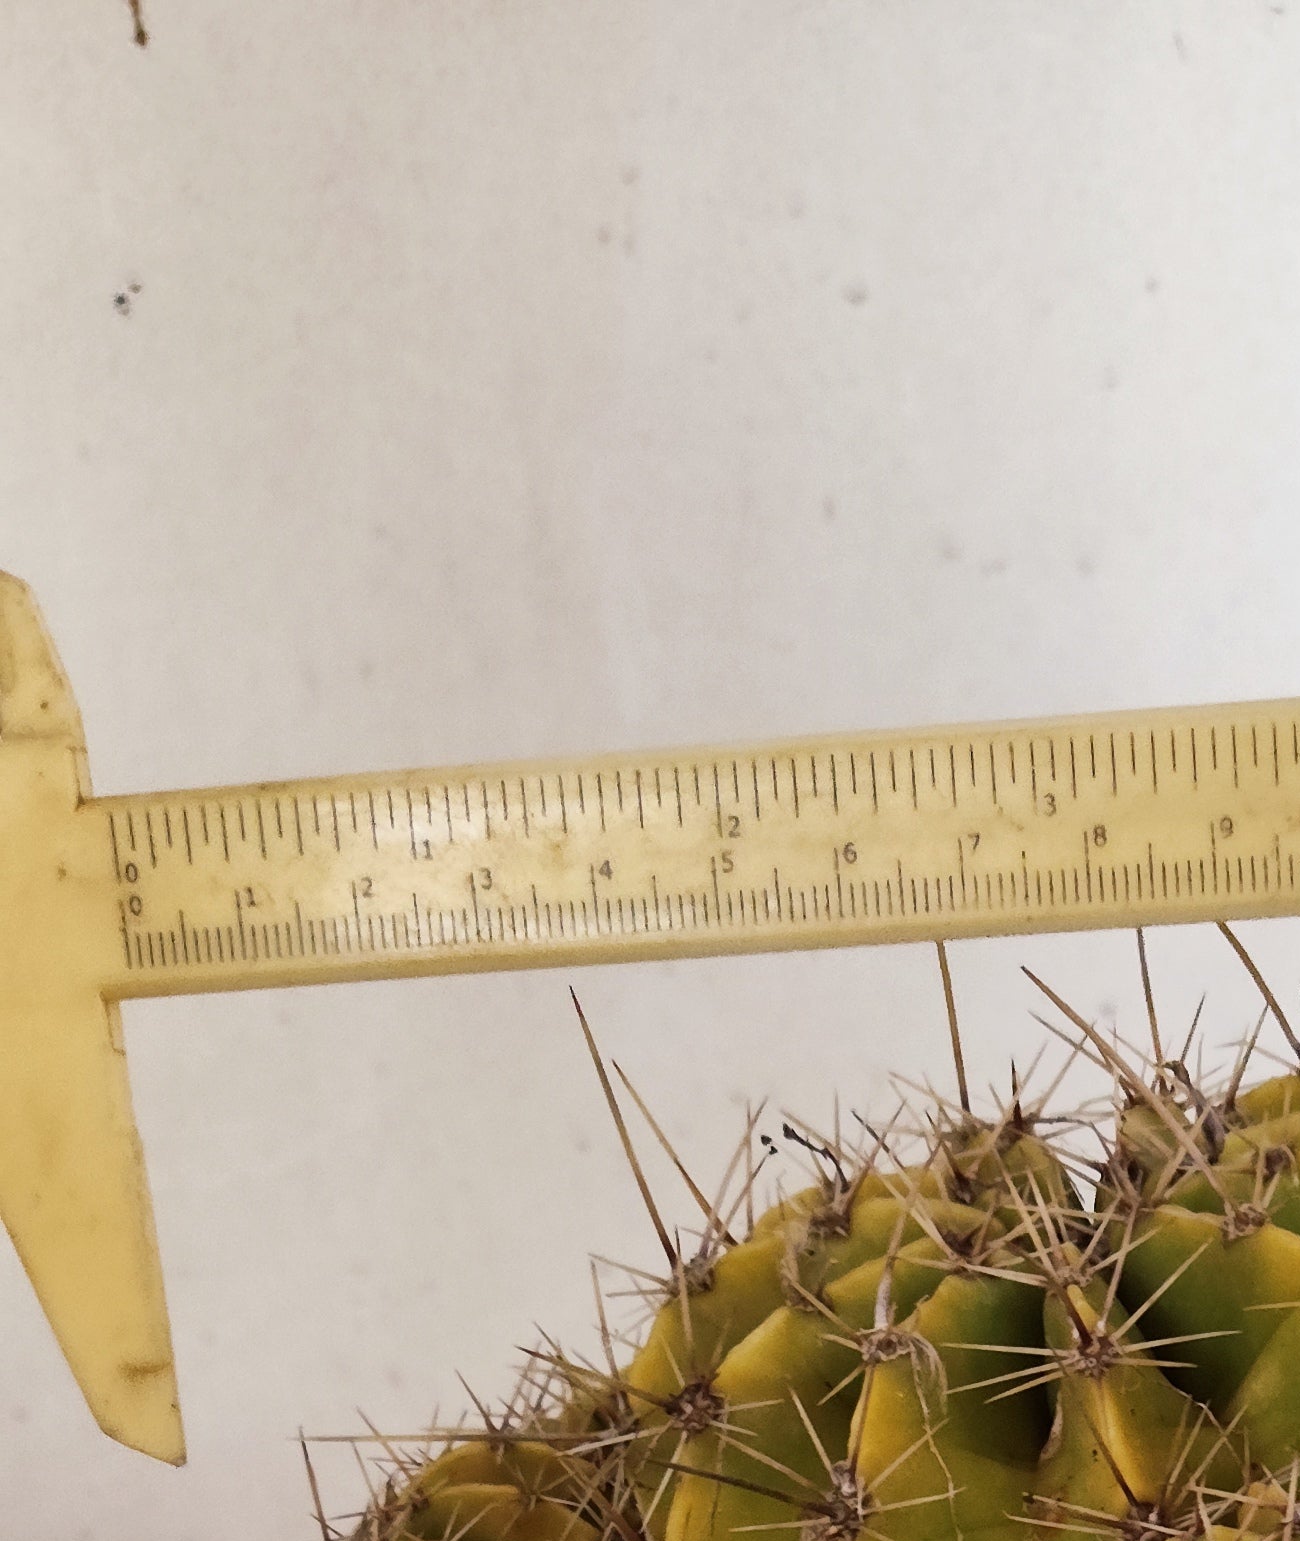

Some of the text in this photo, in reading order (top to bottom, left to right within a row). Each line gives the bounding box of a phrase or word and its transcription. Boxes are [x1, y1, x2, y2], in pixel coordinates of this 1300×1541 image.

[125, 862, 138, 883] 0
[422, 838, 433, 860] 1
[727, 815, 741, 838] 2
[1043, 792, 1057, 817] 3
[129, 895, 142, 916] 0
[246, 886, 257, 908] 1
[360, 876, 374, 898] 2
[478, 867, 493, 890] 3
[599, 859, 613, 880] 4
[720, 850, 734, 873] 5
[842, 841, 858, 865] 6
[967, 831, 981, 851] 7
[1092, 823, 1108, 847] 8
[1218, 815, 1235, 839] 9
